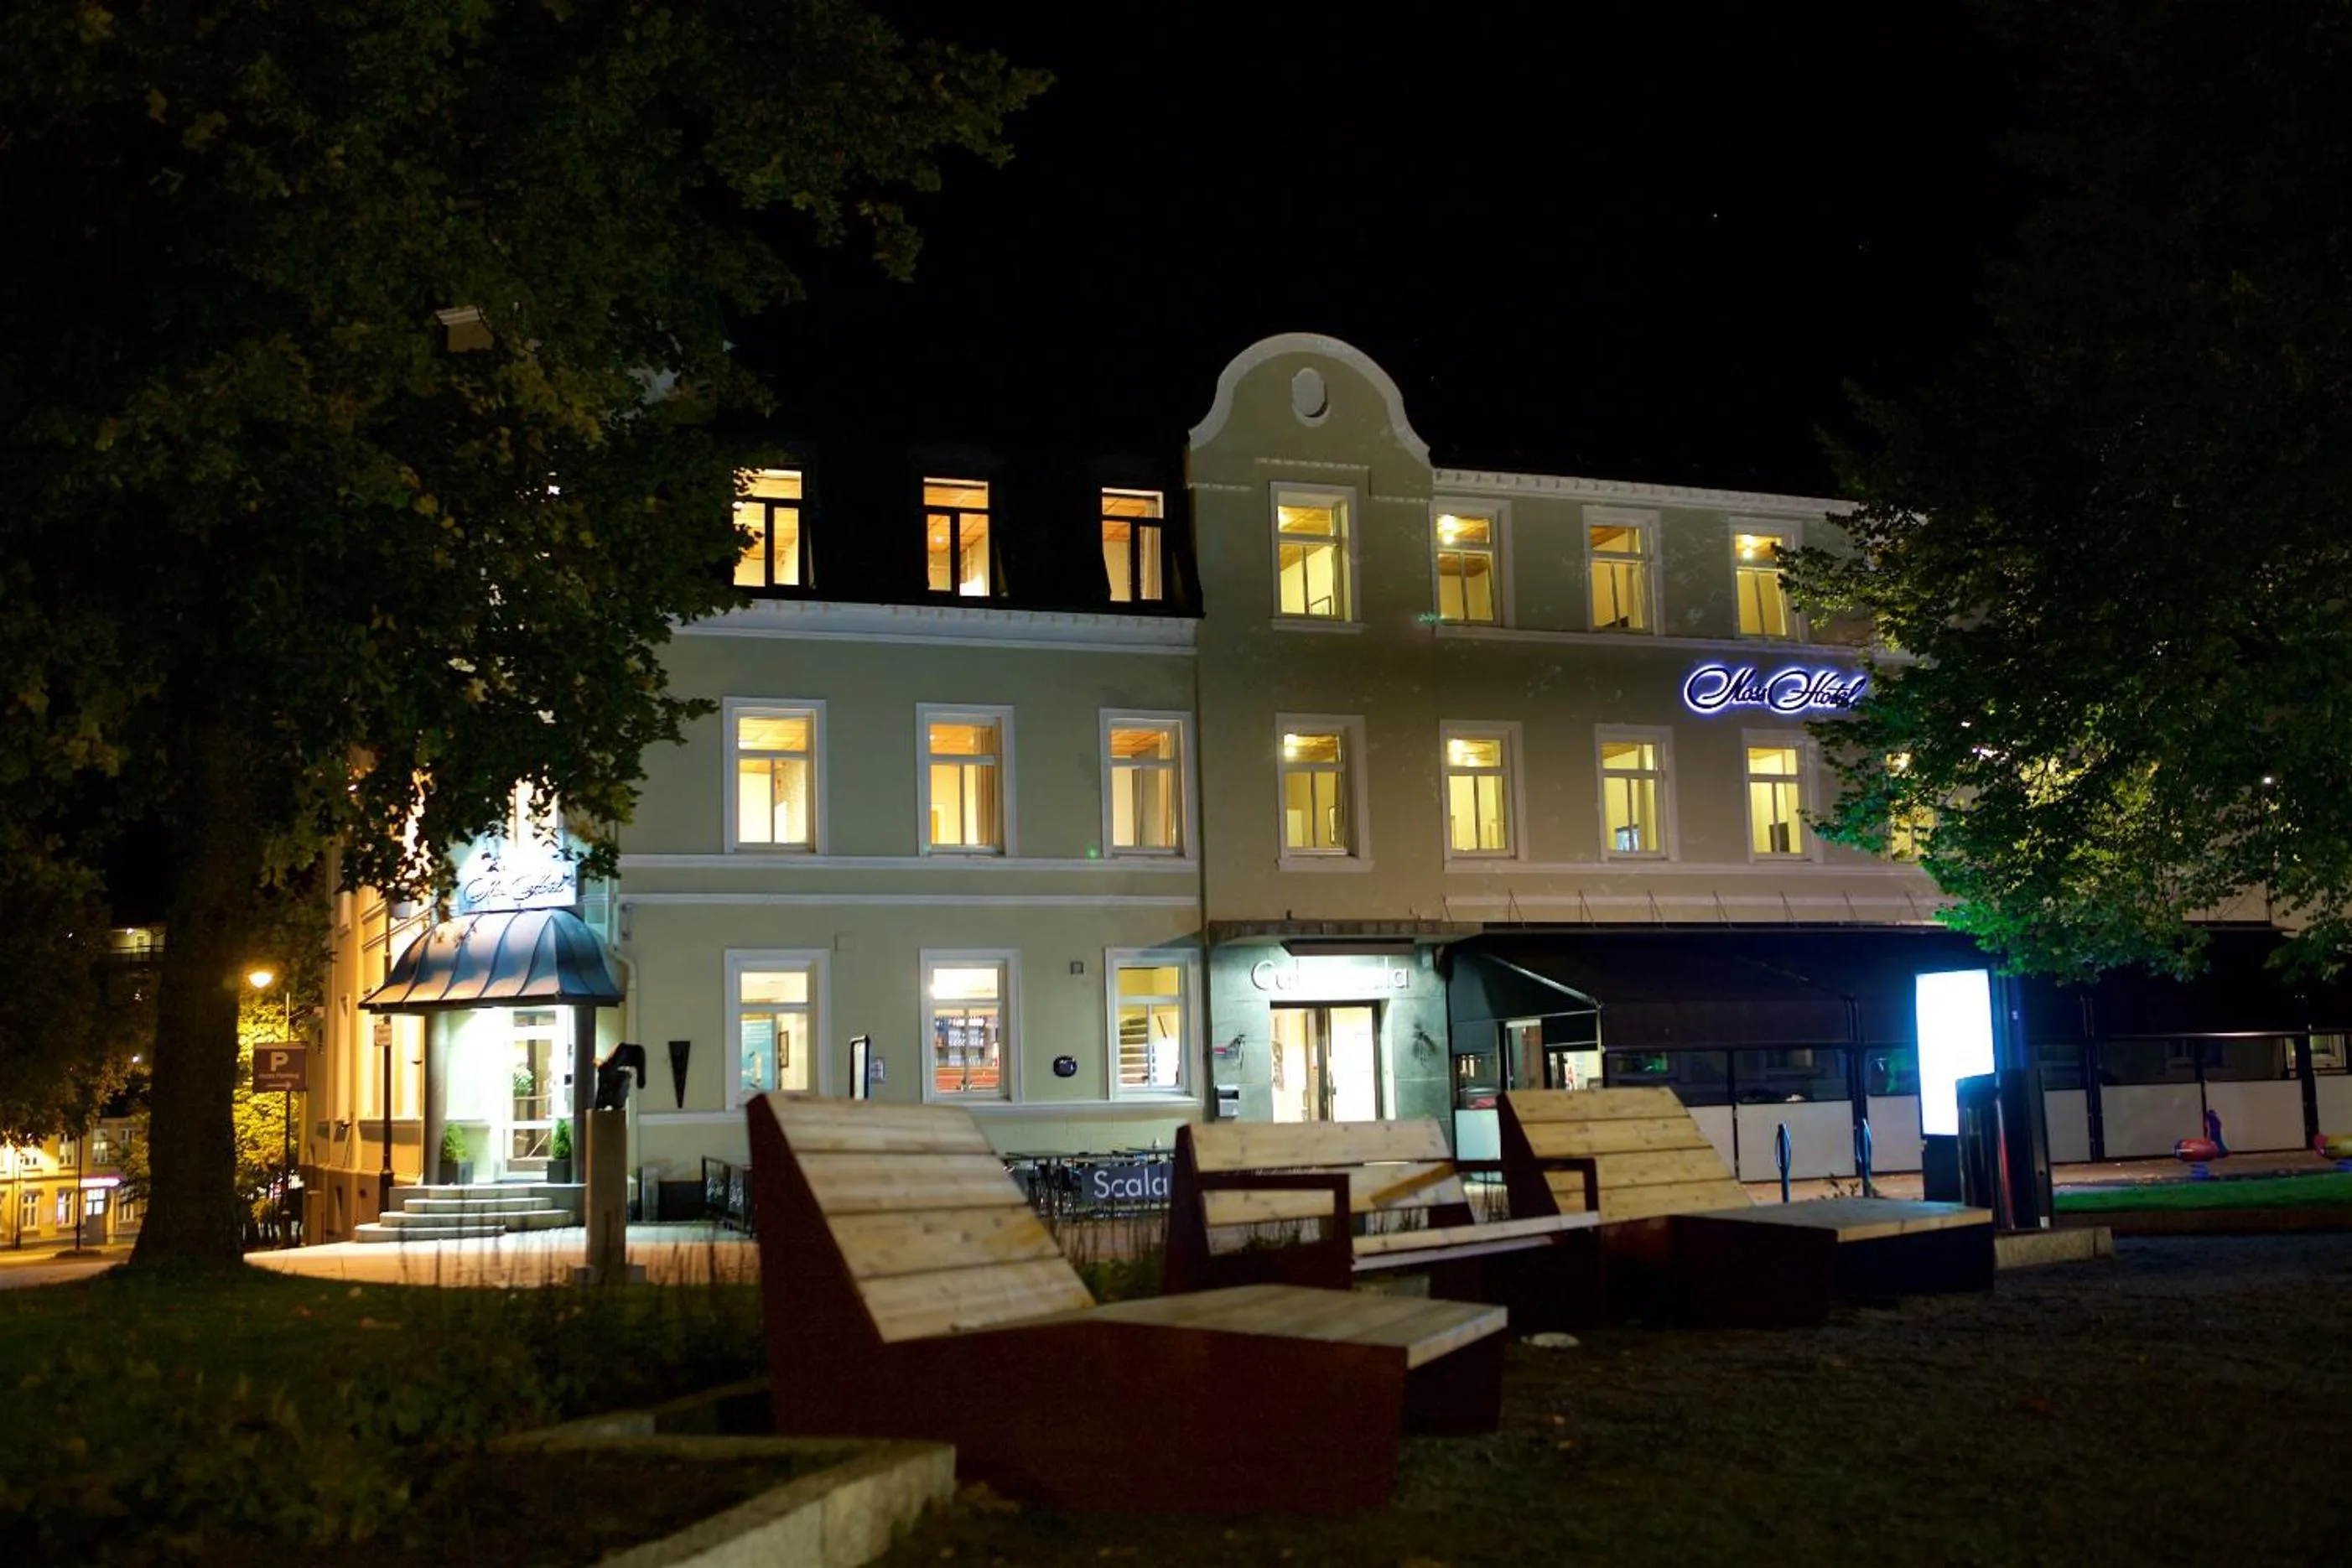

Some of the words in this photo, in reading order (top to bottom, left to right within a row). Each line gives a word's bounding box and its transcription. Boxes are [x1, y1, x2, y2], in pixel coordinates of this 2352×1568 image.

[1685, 665, 1767, 711] Moss
[1767, 668, 1867, 711] Hotel
[270, 1051, 289, 1072] P
[1093, 1168, 1168, 1199] Scala
